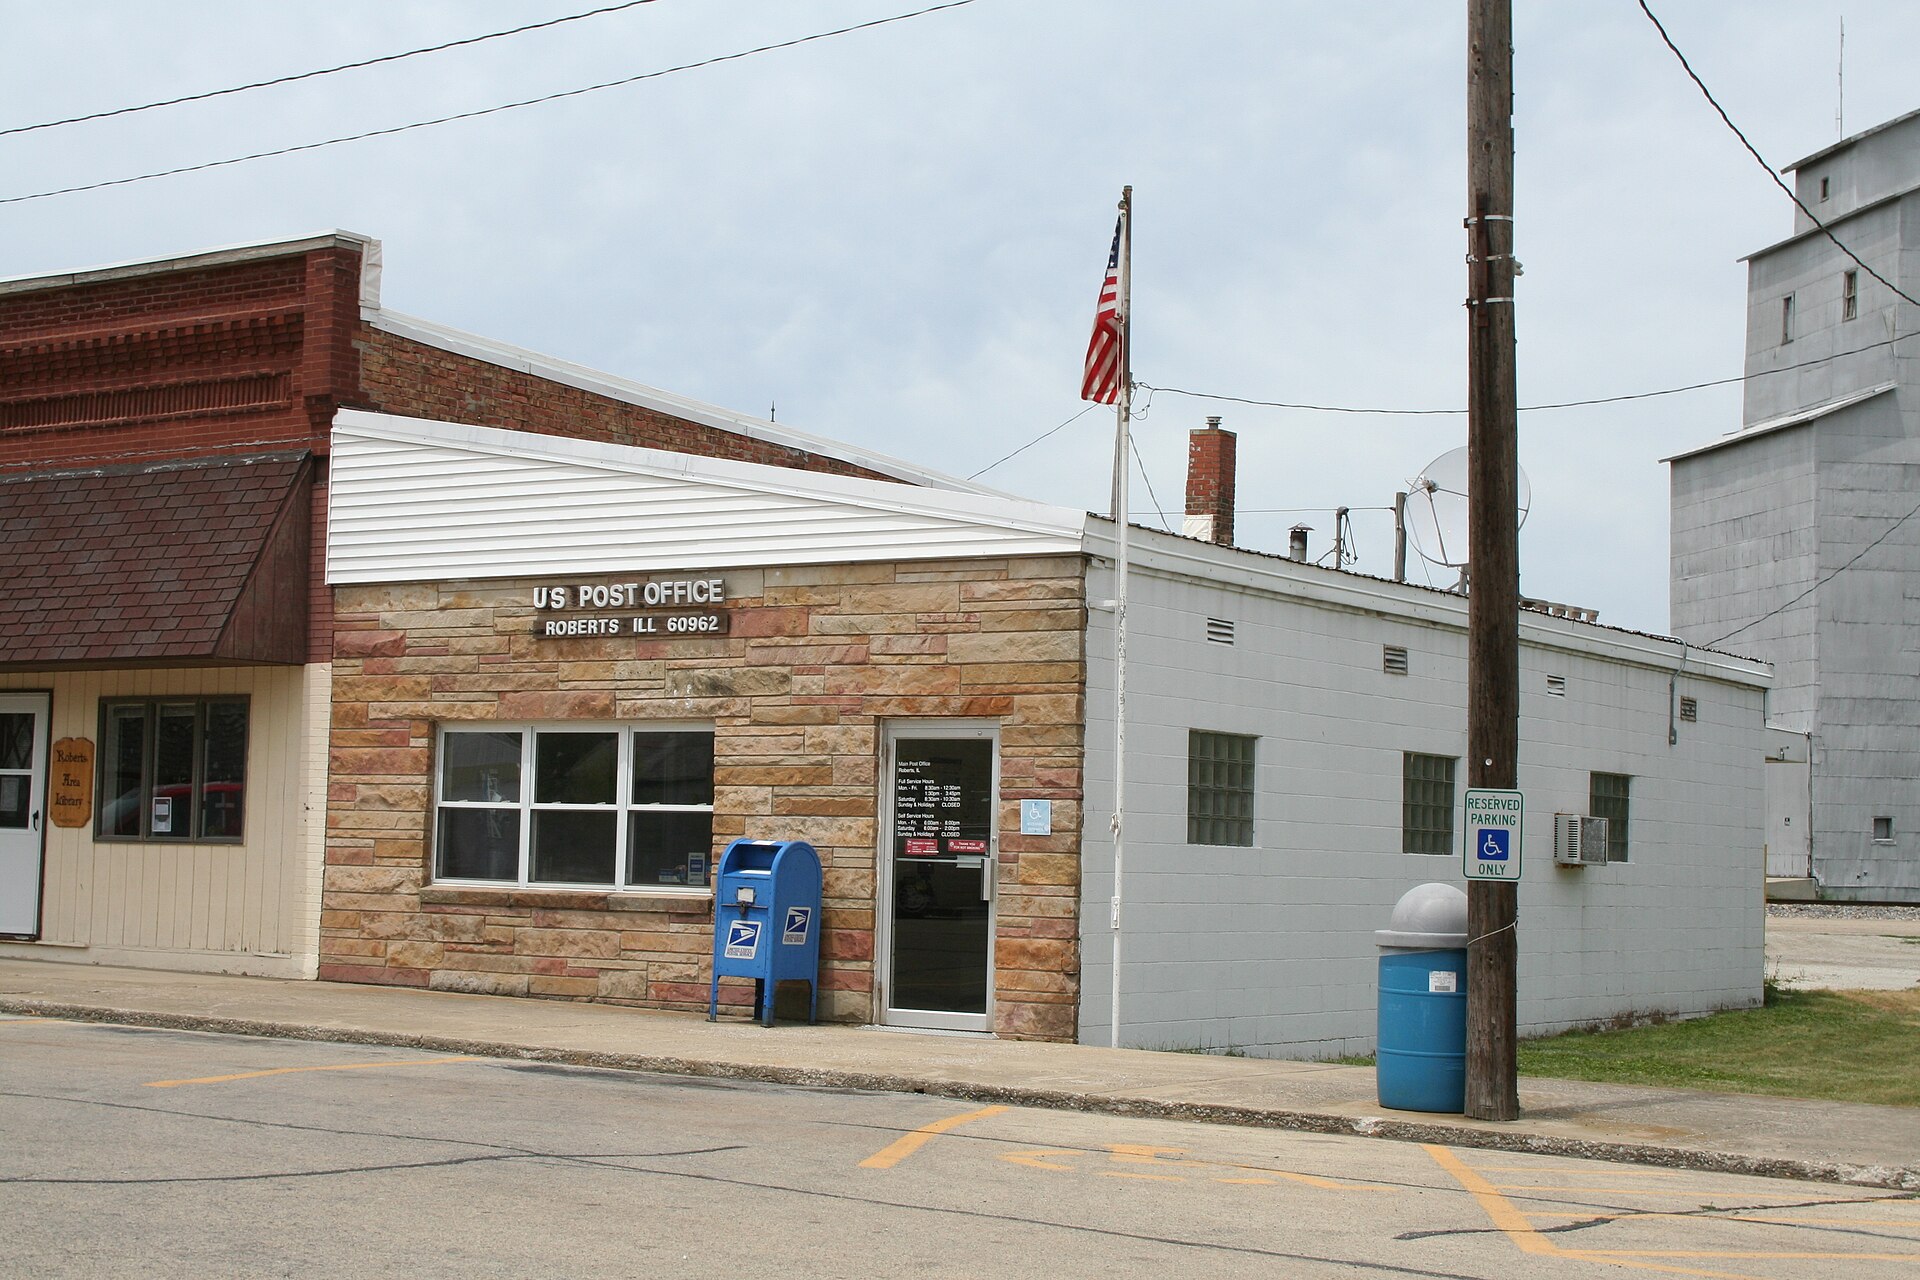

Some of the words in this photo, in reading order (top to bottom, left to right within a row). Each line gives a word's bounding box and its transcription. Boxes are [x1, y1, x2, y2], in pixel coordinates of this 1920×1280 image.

[533, 587, 565, 609] US
[579, 583, 638, 608] POST
[644, 579, 725, 605] OFFICE
[545, 618, 619, 636] ROBERTS
[633, 617, 656, 633] ILL
[667, 615, 719, 632] 60962
[56, 749, 88, 763] Roberts
[62, 773, 81, 787] Area
[55, 792, 84, 809] Library
[1467, 797, 1520, 811] RESERVED
[1470, 813, 1516, 826] PARKING
[1478, 863, 1507, 876] ONLY
